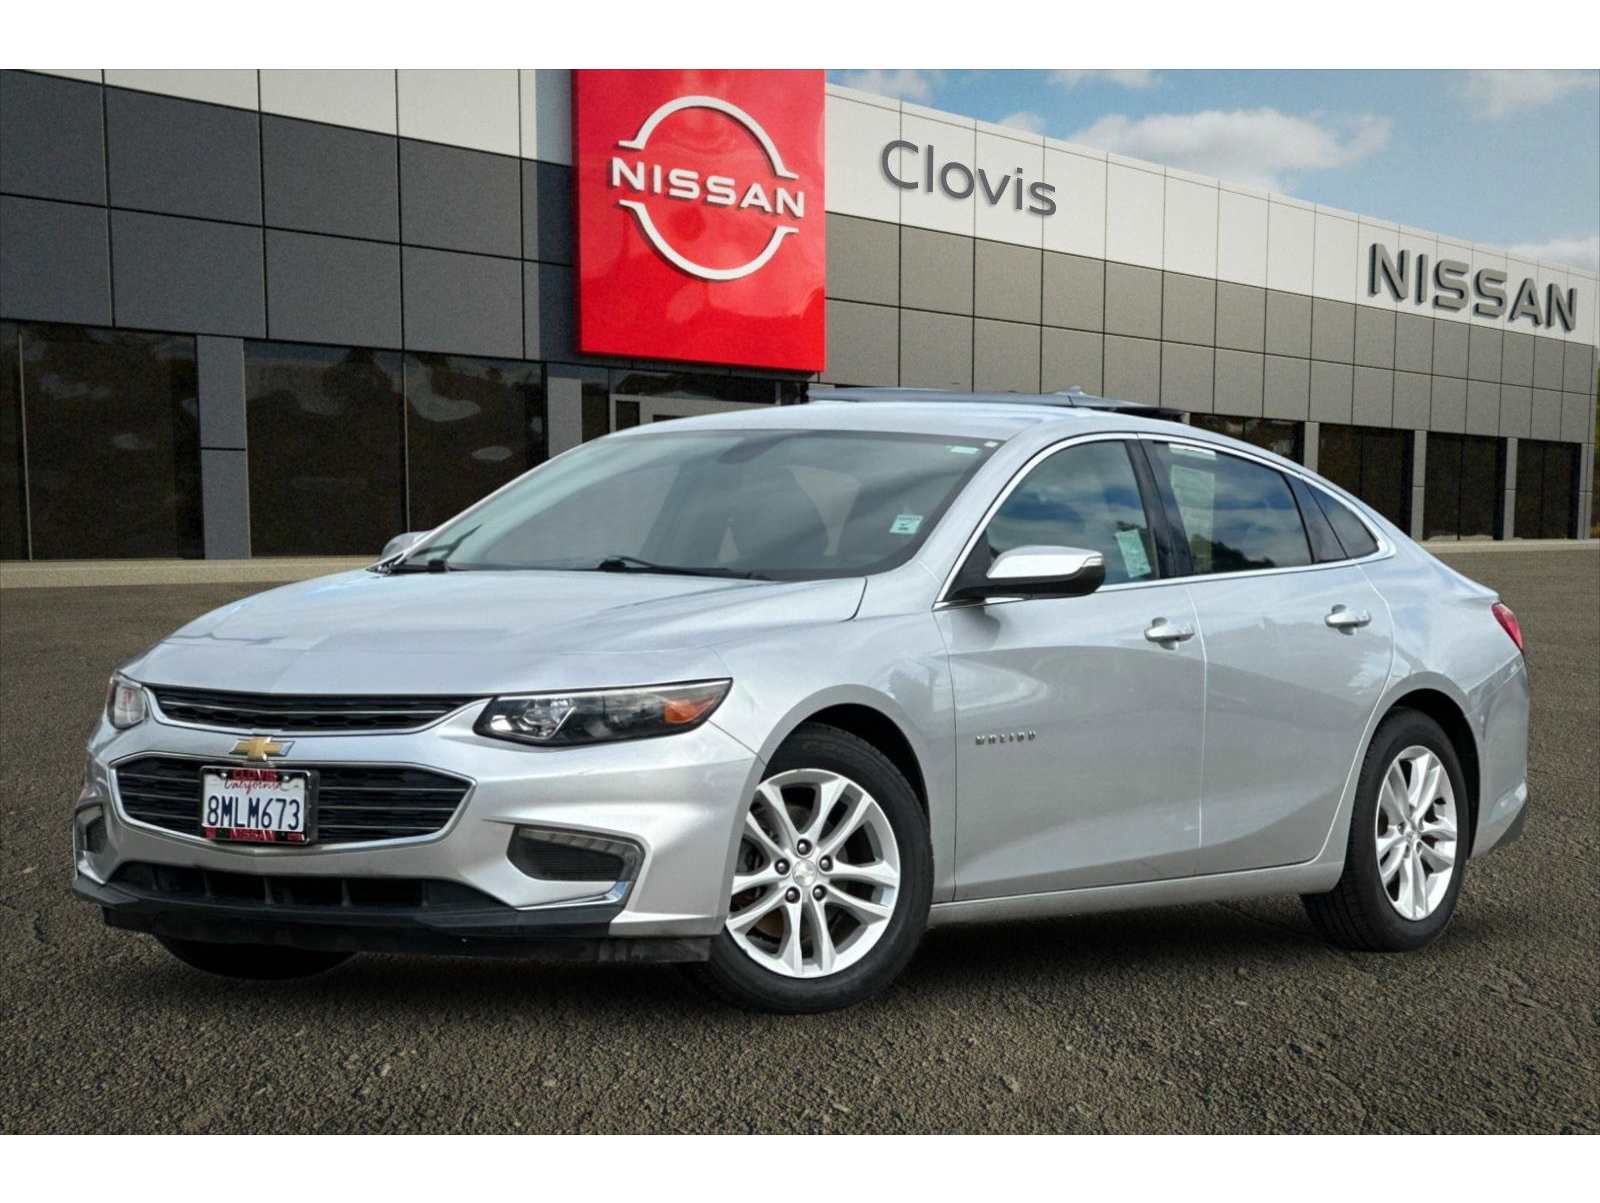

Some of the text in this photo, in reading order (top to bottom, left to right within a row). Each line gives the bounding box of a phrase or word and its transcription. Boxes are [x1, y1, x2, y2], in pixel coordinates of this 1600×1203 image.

[611, 157, 804, 217] NISSAN
[881, 139, 1057, 216] Clovis
[1368, 242, 1577, 332] NISSAN
[207, 795, 300, 831] 8MLM673
